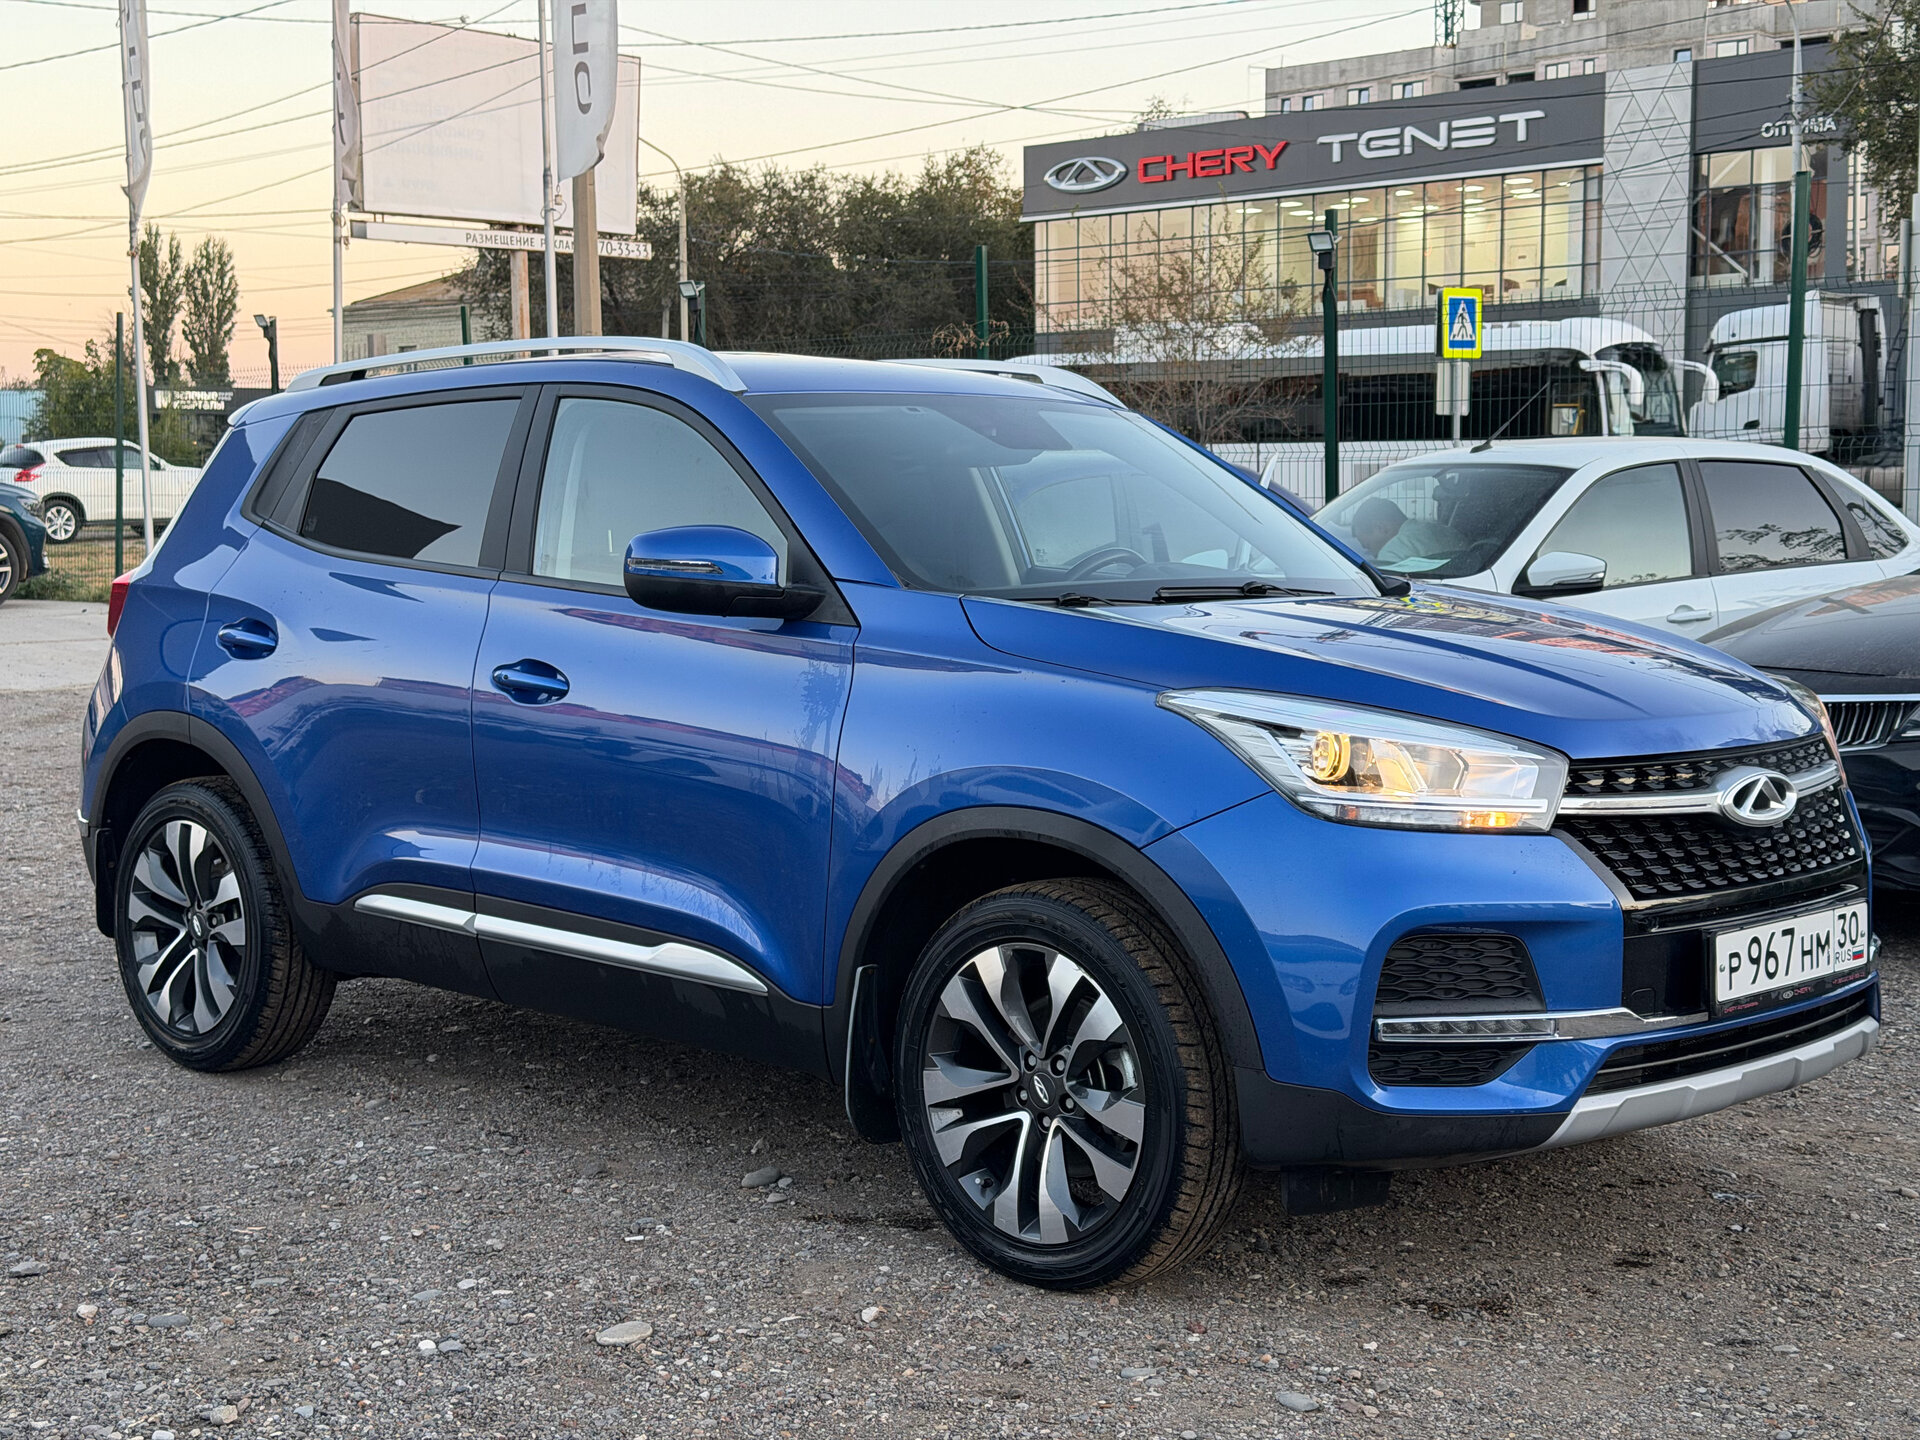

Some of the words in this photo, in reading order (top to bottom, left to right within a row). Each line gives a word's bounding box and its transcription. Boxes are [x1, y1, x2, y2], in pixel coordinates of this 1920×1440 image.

[1137, 141, 1289, 184] CHERY
[1317, 110, 1546, 163] TENET
[465, 232, 535, 249] РАЗМЕЩЕНИЕ
[599, 241, 649, 258] 70-33-33
[1837, 911, 1859, 949] 30
[1835, 950, 1852, 965] RUS
